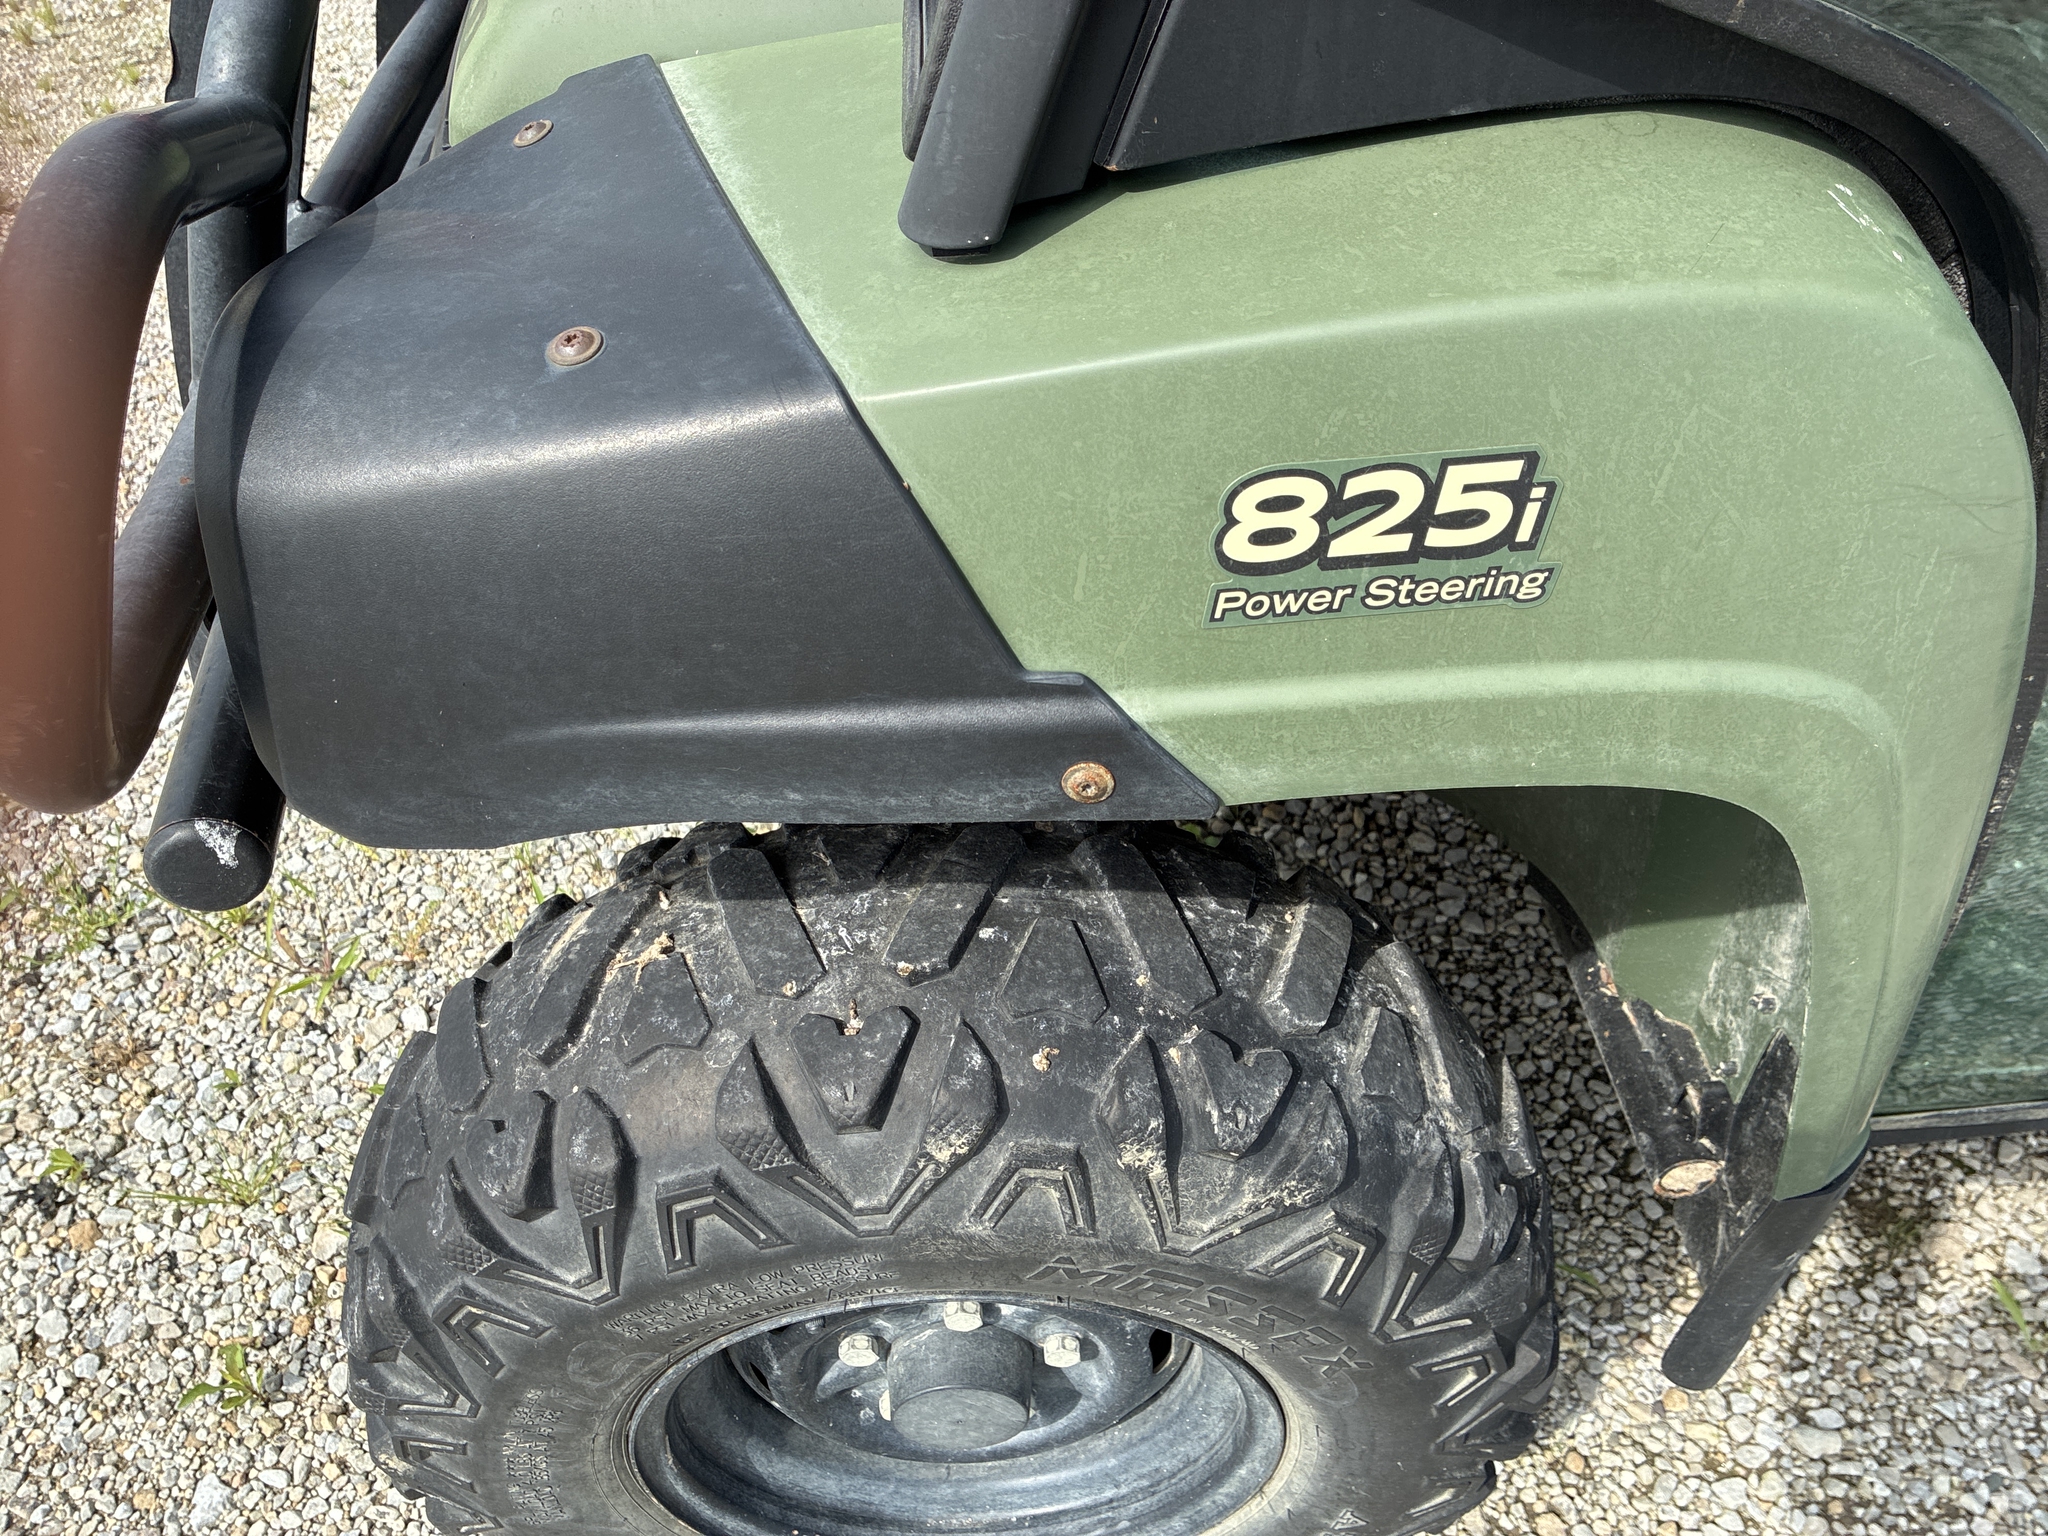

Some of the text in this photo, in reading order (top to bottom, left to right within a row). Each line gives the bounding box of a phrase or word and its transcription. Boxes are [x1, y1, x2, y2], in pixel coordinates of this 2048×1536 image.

[1217, 454, 1553, 571] 825i
[1211, 567, 1551, 621] Power Steering
[643, 1311, 675, 1327] PSI
[681, 1298, 716, 1314] MAX
[725, 1290, 748, 1302] TO
[754, 1276, 800, 1293] SEAT
[809, 1264, 871, 1283] BEADS
[680, 1281, 739, 1303] EXTRA
[746, 1268, 784, 1287] LOW
[715, 1284, 810, 1312] OPERATING
[812, 1269, 900, 1290] PRESSURE
